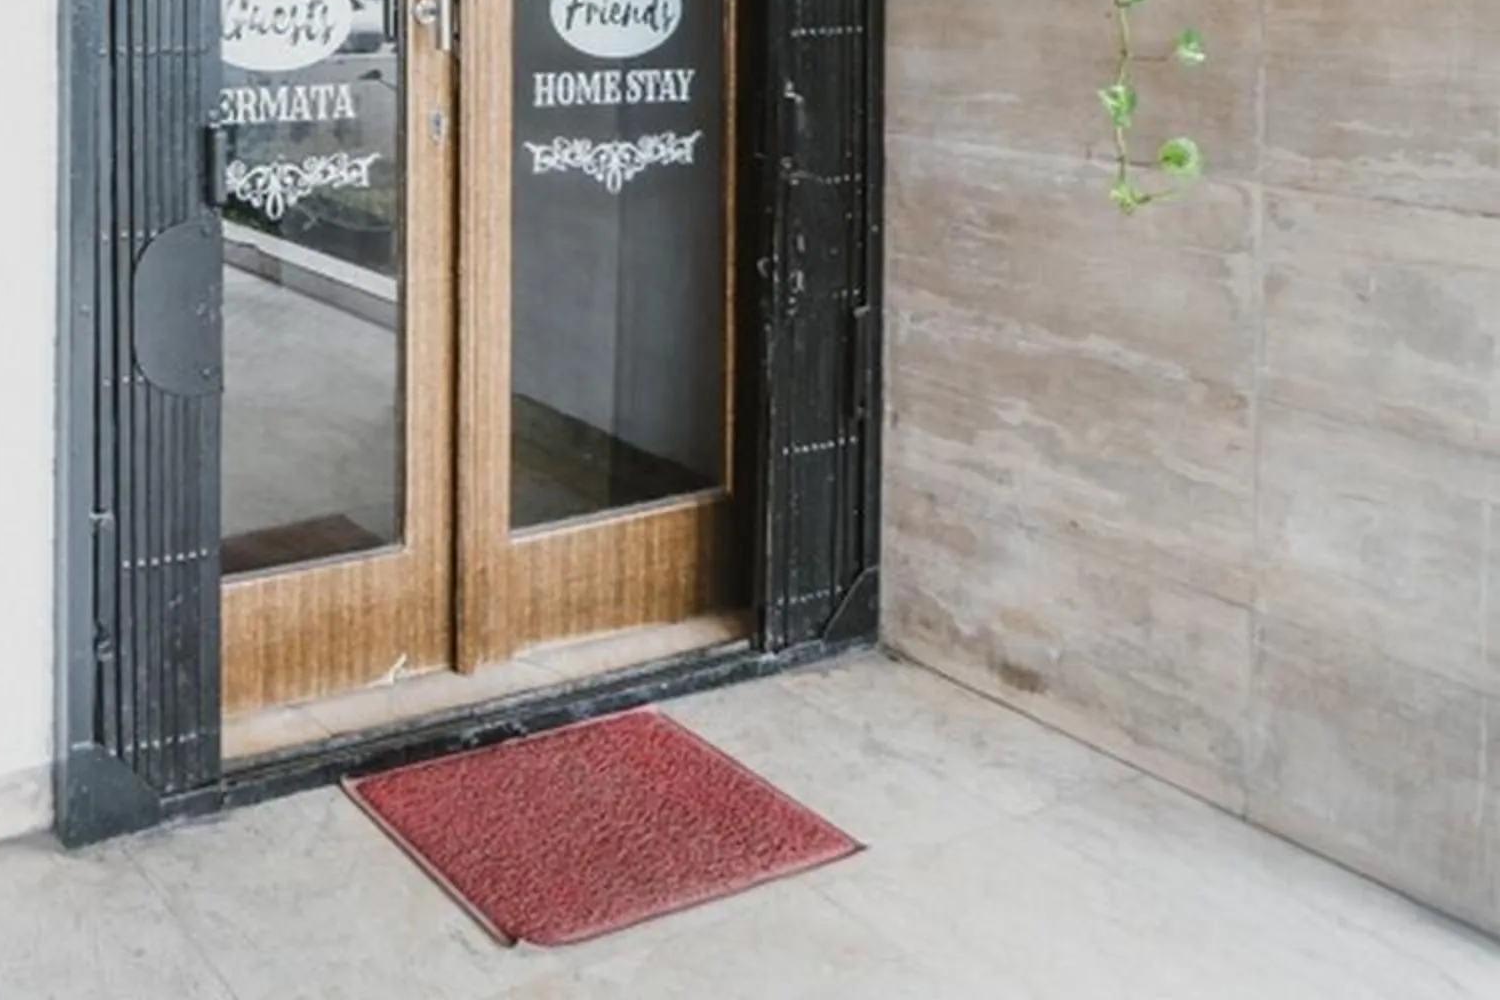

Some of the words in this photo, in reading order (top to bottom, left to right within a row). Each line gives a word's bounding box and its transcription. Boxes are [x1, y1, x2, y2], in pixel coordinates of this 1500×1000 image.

[218, 83, 356, 126] ERMATA
[532, 69, 622, 108] HOME
[625, 68, 696, 102] STAY
